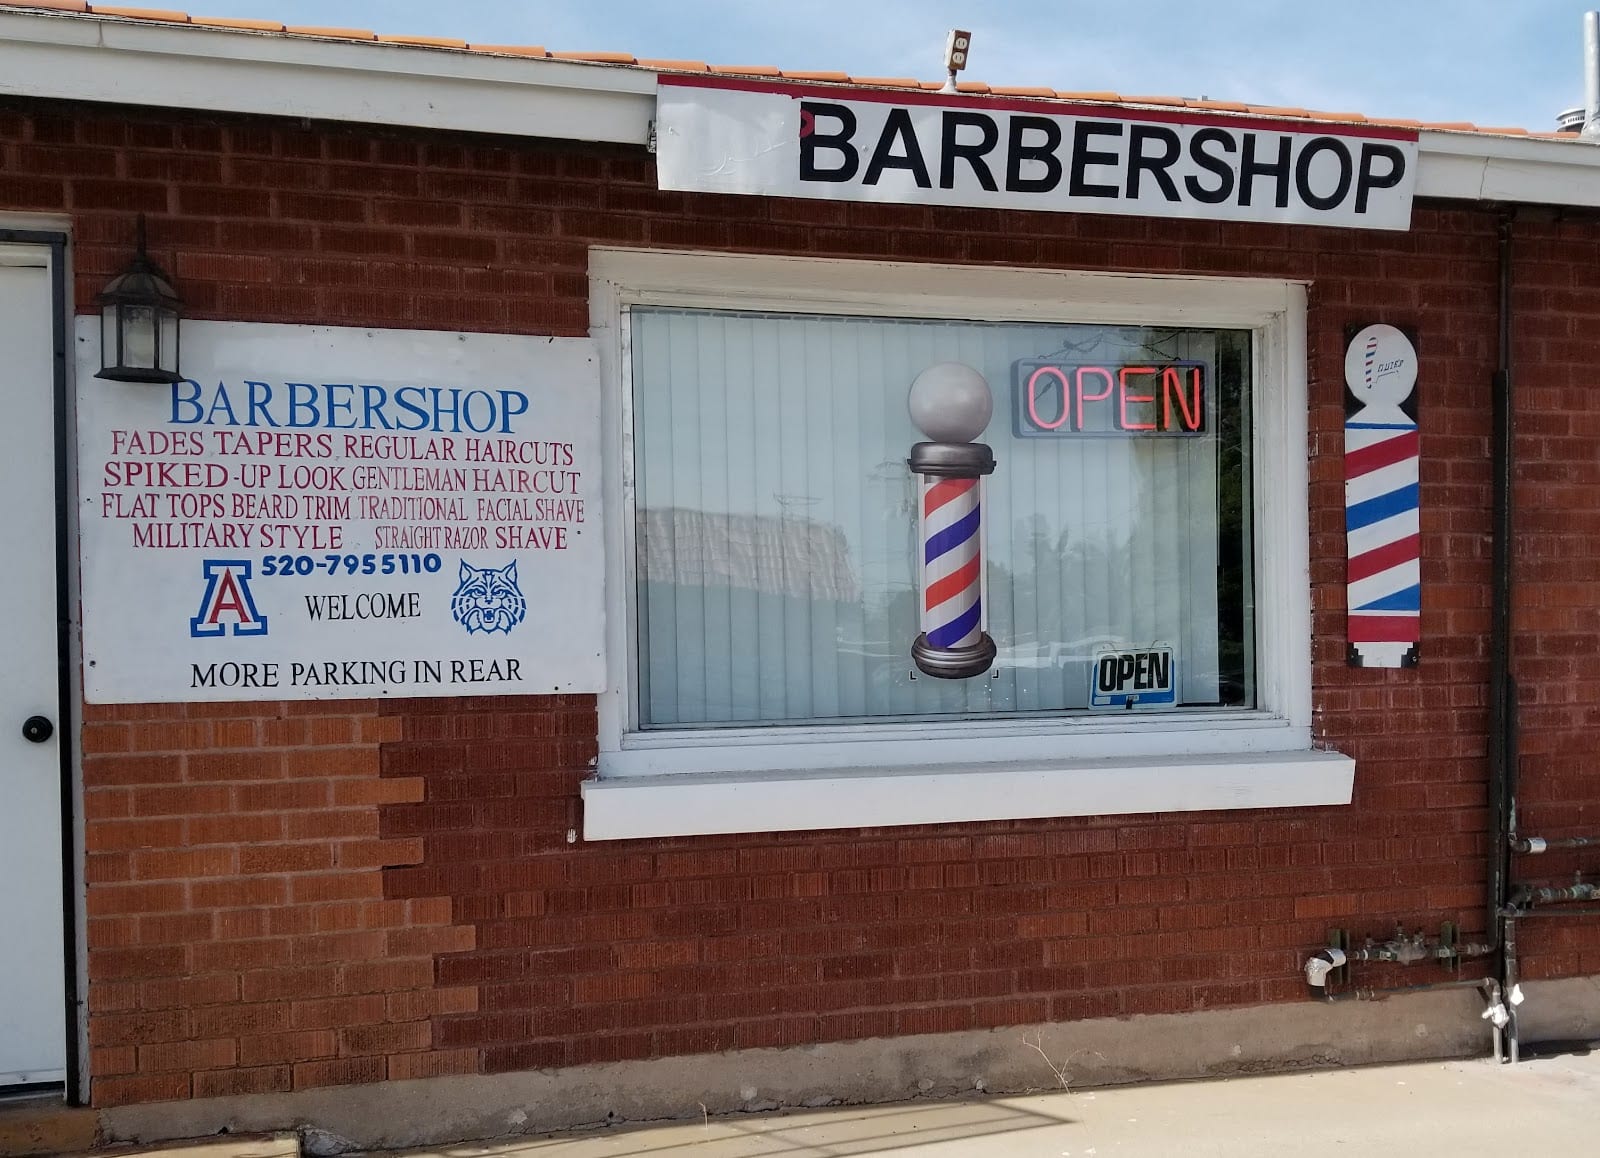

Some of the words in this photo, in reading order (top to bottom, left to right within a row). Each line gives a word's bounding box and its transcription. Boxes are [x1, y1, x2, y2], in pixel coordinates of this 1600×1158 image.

[799, 101, 1406, 214] BARBERSHOP
[167, 379, 529, 434] BARBERSHOP
[1028, 366, 1200, 429] OPEN
[112, 431, 203, 455] FADES
[214, 432, 332, 457] TAPERS
[344, 435, 456, 460] REGULAR
[466, 439, 573, 466] HAIRCUTS
[278, 464, 347, 491] LOOK
[353, 466, 466, 491] GENTLEMAN
[472, 469, 580, 494] HAIRCUT
[102, 493, 159, 518] FLAT
[166, 494, 225, 518] TOPS
[232, 493, 297, 519] BEARD
[303, 496, 350, 520] TRIM
[361, 496, 467, 520] TRADITIONAL
[478, 499, 532, 521] FACIAL
[536, 499, 584, 522] SHAVE
[133, 522, 254, 548] MILITARY
[260, 524, 342, 549] STYLE
[376, 526, 441, 549] STRAIGHT
[445, 527, 486, 549] RAZOR
[496, 526, 566, 550] SHAVE
[305, 593, 420, 620] WELCOME
[191, 662, 278, 687] MORE
[292, 661, 405, 685] PARKING
[414, 661, 441, 682] IN
[451, 659, 522, 682] REAR
[1099, 652, 1169, 692] OPEN
